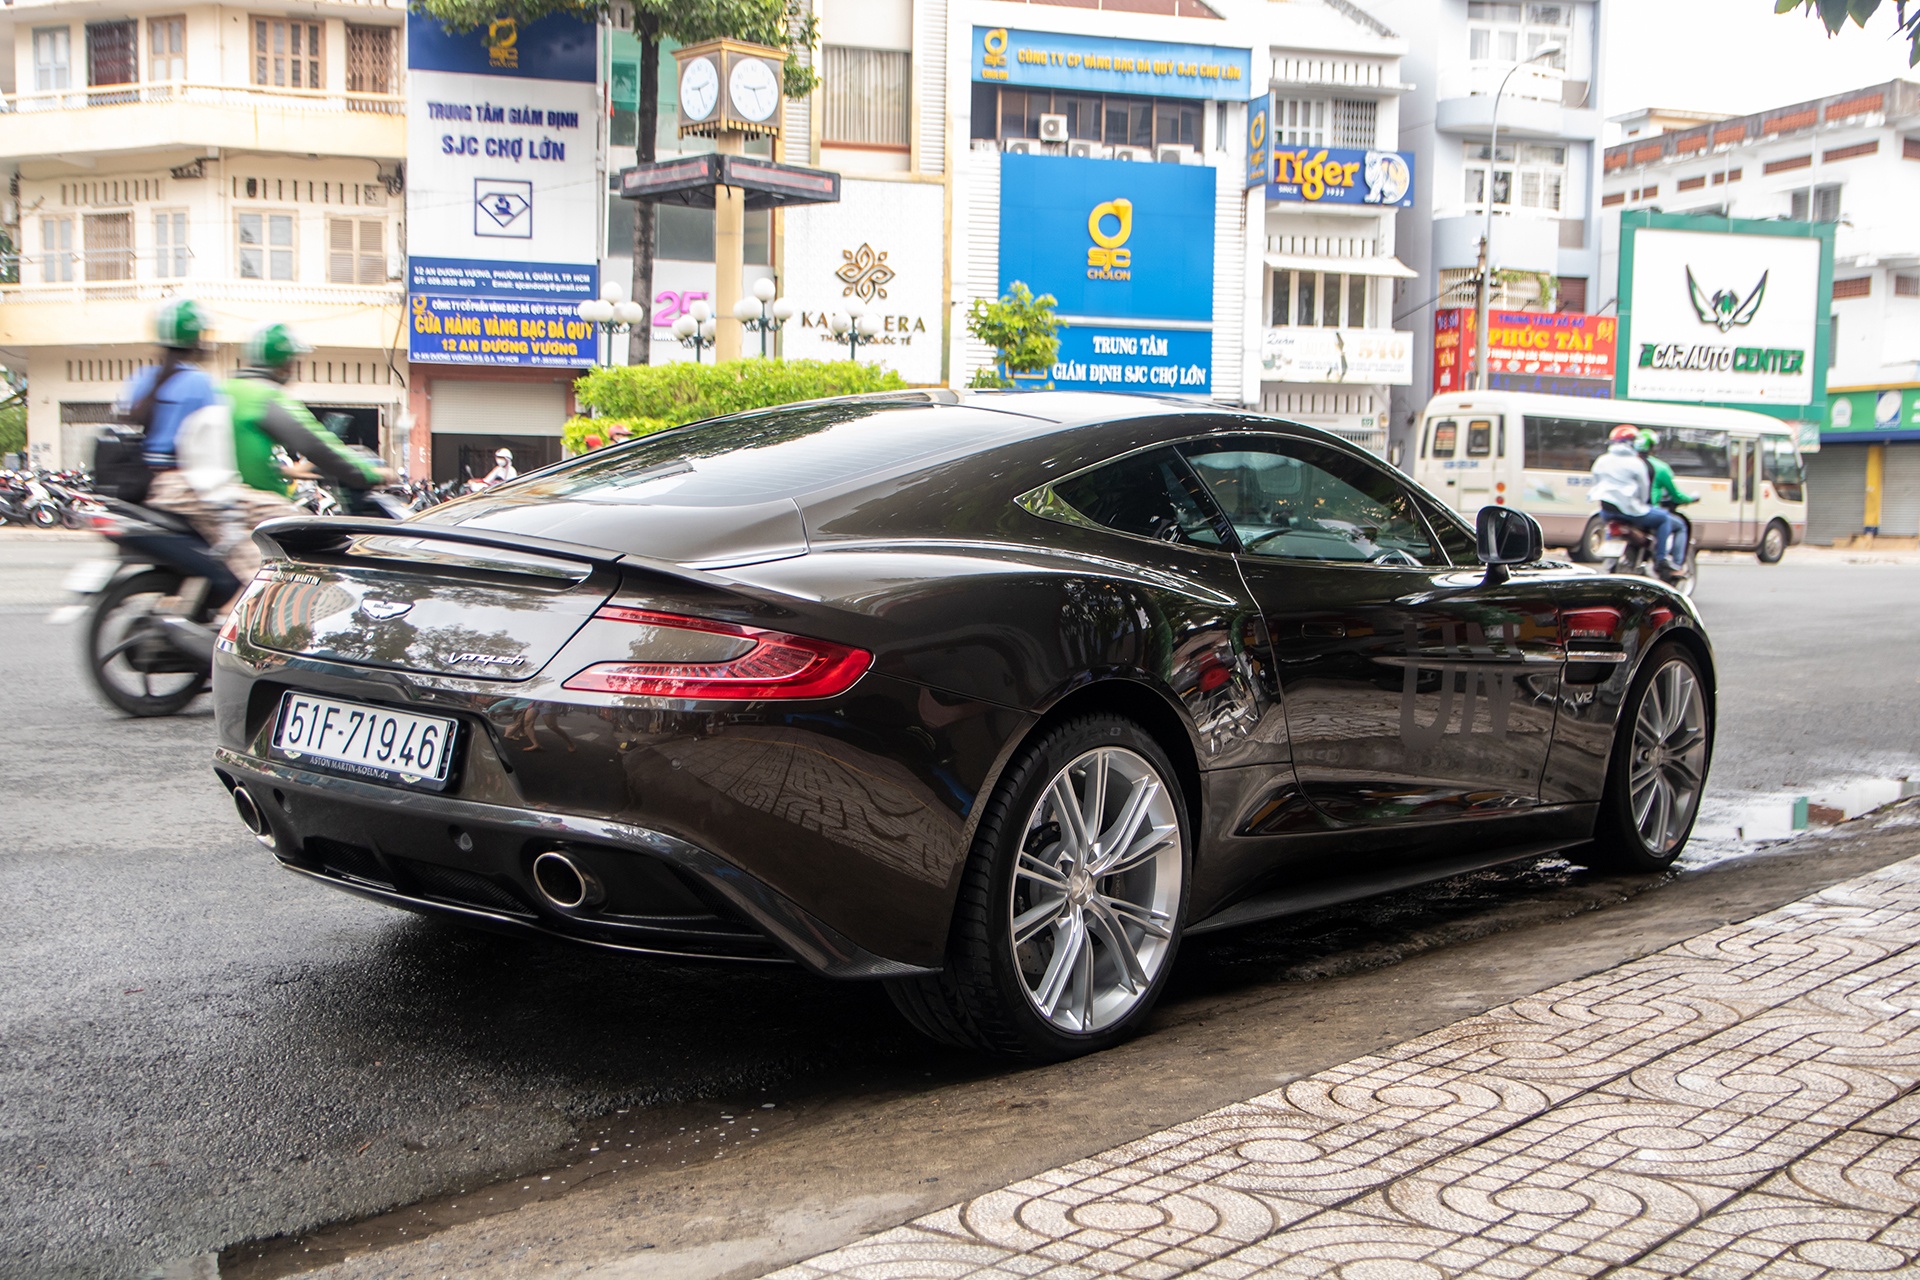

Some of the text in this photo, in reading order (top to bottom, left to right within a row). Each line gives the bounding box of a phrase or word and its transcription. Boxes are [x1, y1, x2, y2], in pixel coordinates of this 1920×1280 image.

[1017, 48, 1048, 65] CÔNG
[1050, 52, 1064, 67] TY
[1066, 54, 1082, 68] CP
[1084, 52, 1111, 70] VÀNG
[1114, 57, 1134, 75] BẠC
[1153, 58, 1174, 76] QUÝ
[1176, 62, 1197, 77] SJC
[1200, 64, 1220, 80] CHỢ
[1221, 64, 1241, 80] LỚN
[427, 101, 579, 130] TRUNG TÂM GIÁM ĐỊNH
[442, 135, 566, 163] SJC CHỢ LỚN
[1274, 149, 1360, 201] Tiger
[1278, 185, 1345, 198] SINCE 1932
[1087, 269, 1130, 281] CHOLON
[444, 313, 480, 336] HÀNG
[484, 314, 518, 338] VÀNG
[521, 320, 546, 341] BẠC
[548, 318, 565, 339] ĐÁ
[1498, 314, 1530, 325] TRUNG
[1533, 314, 1553, 326] TÂM
[441, 340, 578, 356] 12 AN DƯƠNG VƯƠNG
[1093, 334, 1168, 356] TRUNG TÂM
[1488, 324, 1594, 350] PHÚC TÀI
[1732, 347, 1805, 374] CENTER
[1052, 360, 1206, 388] GIÁM ĐỊNH SJC CHỢ LỚN
[294, 573, 322, 586] MARTIN
[448, 652, 525, 666] Vanquish
[288, 701, 439, 770] 51F-719.46
[310, 756, 389, 780] ASTON MARTIN-KOELN.de
